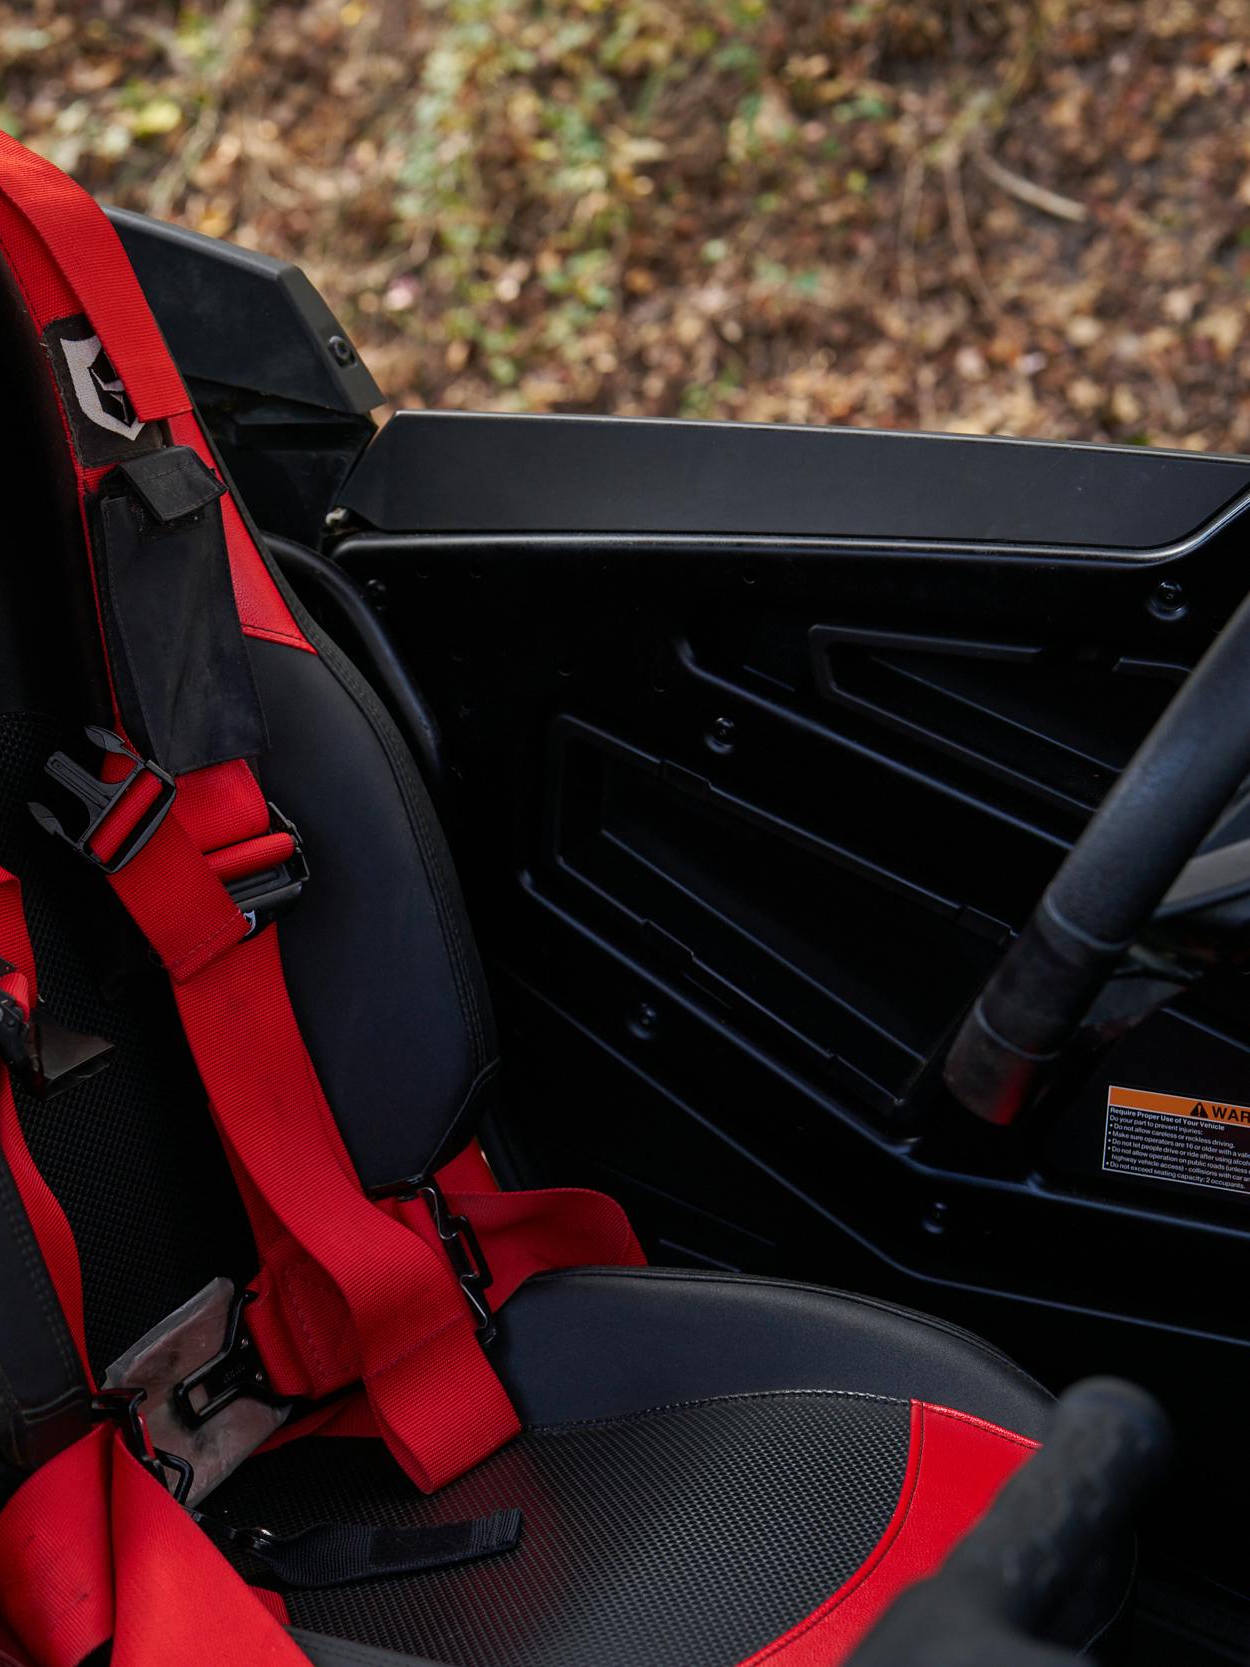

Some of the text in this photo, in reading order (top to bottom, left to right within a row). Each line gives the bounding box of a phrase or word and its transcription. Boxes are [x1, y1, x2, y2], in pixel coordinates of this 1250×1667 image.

[1110, 1107, 1136, 1116] Require
[1137, 1112, 1160, 1120] Proper
[1200, 1121, 1224, 1130] Vehicle
[1212, 1106, 1250, 1122] WAR
[1154, 1123, 1178, 1131] prevent
[1179, 1126, 1203, 1135] injuries:
[1112, 1131, 1129, 1139] Make
[1144, 1137, 1174, 1146] operators
[1185, 1136, 1211, 1144] reckless
[1212, 1139, 1235, 1149] driving.
[1141, 1144, 1162, 1152] people
[1112, 1154, 1137, 1164] highway
[1138, 1159, 1159, 1167] vehicle
[1160, 1162, 1184, 1172] access)
[1188, 1168, 1217, 1177] collisions
[1149, 1153, 1178, 1162] operation
[1226, 1165, 1247, 1174] (unless
[1154, 1169, 1176, 1178] seating
[1177, 1173, 1205, 1183] capacity:
[1211, 1179, 1245, 1189] occupants.
